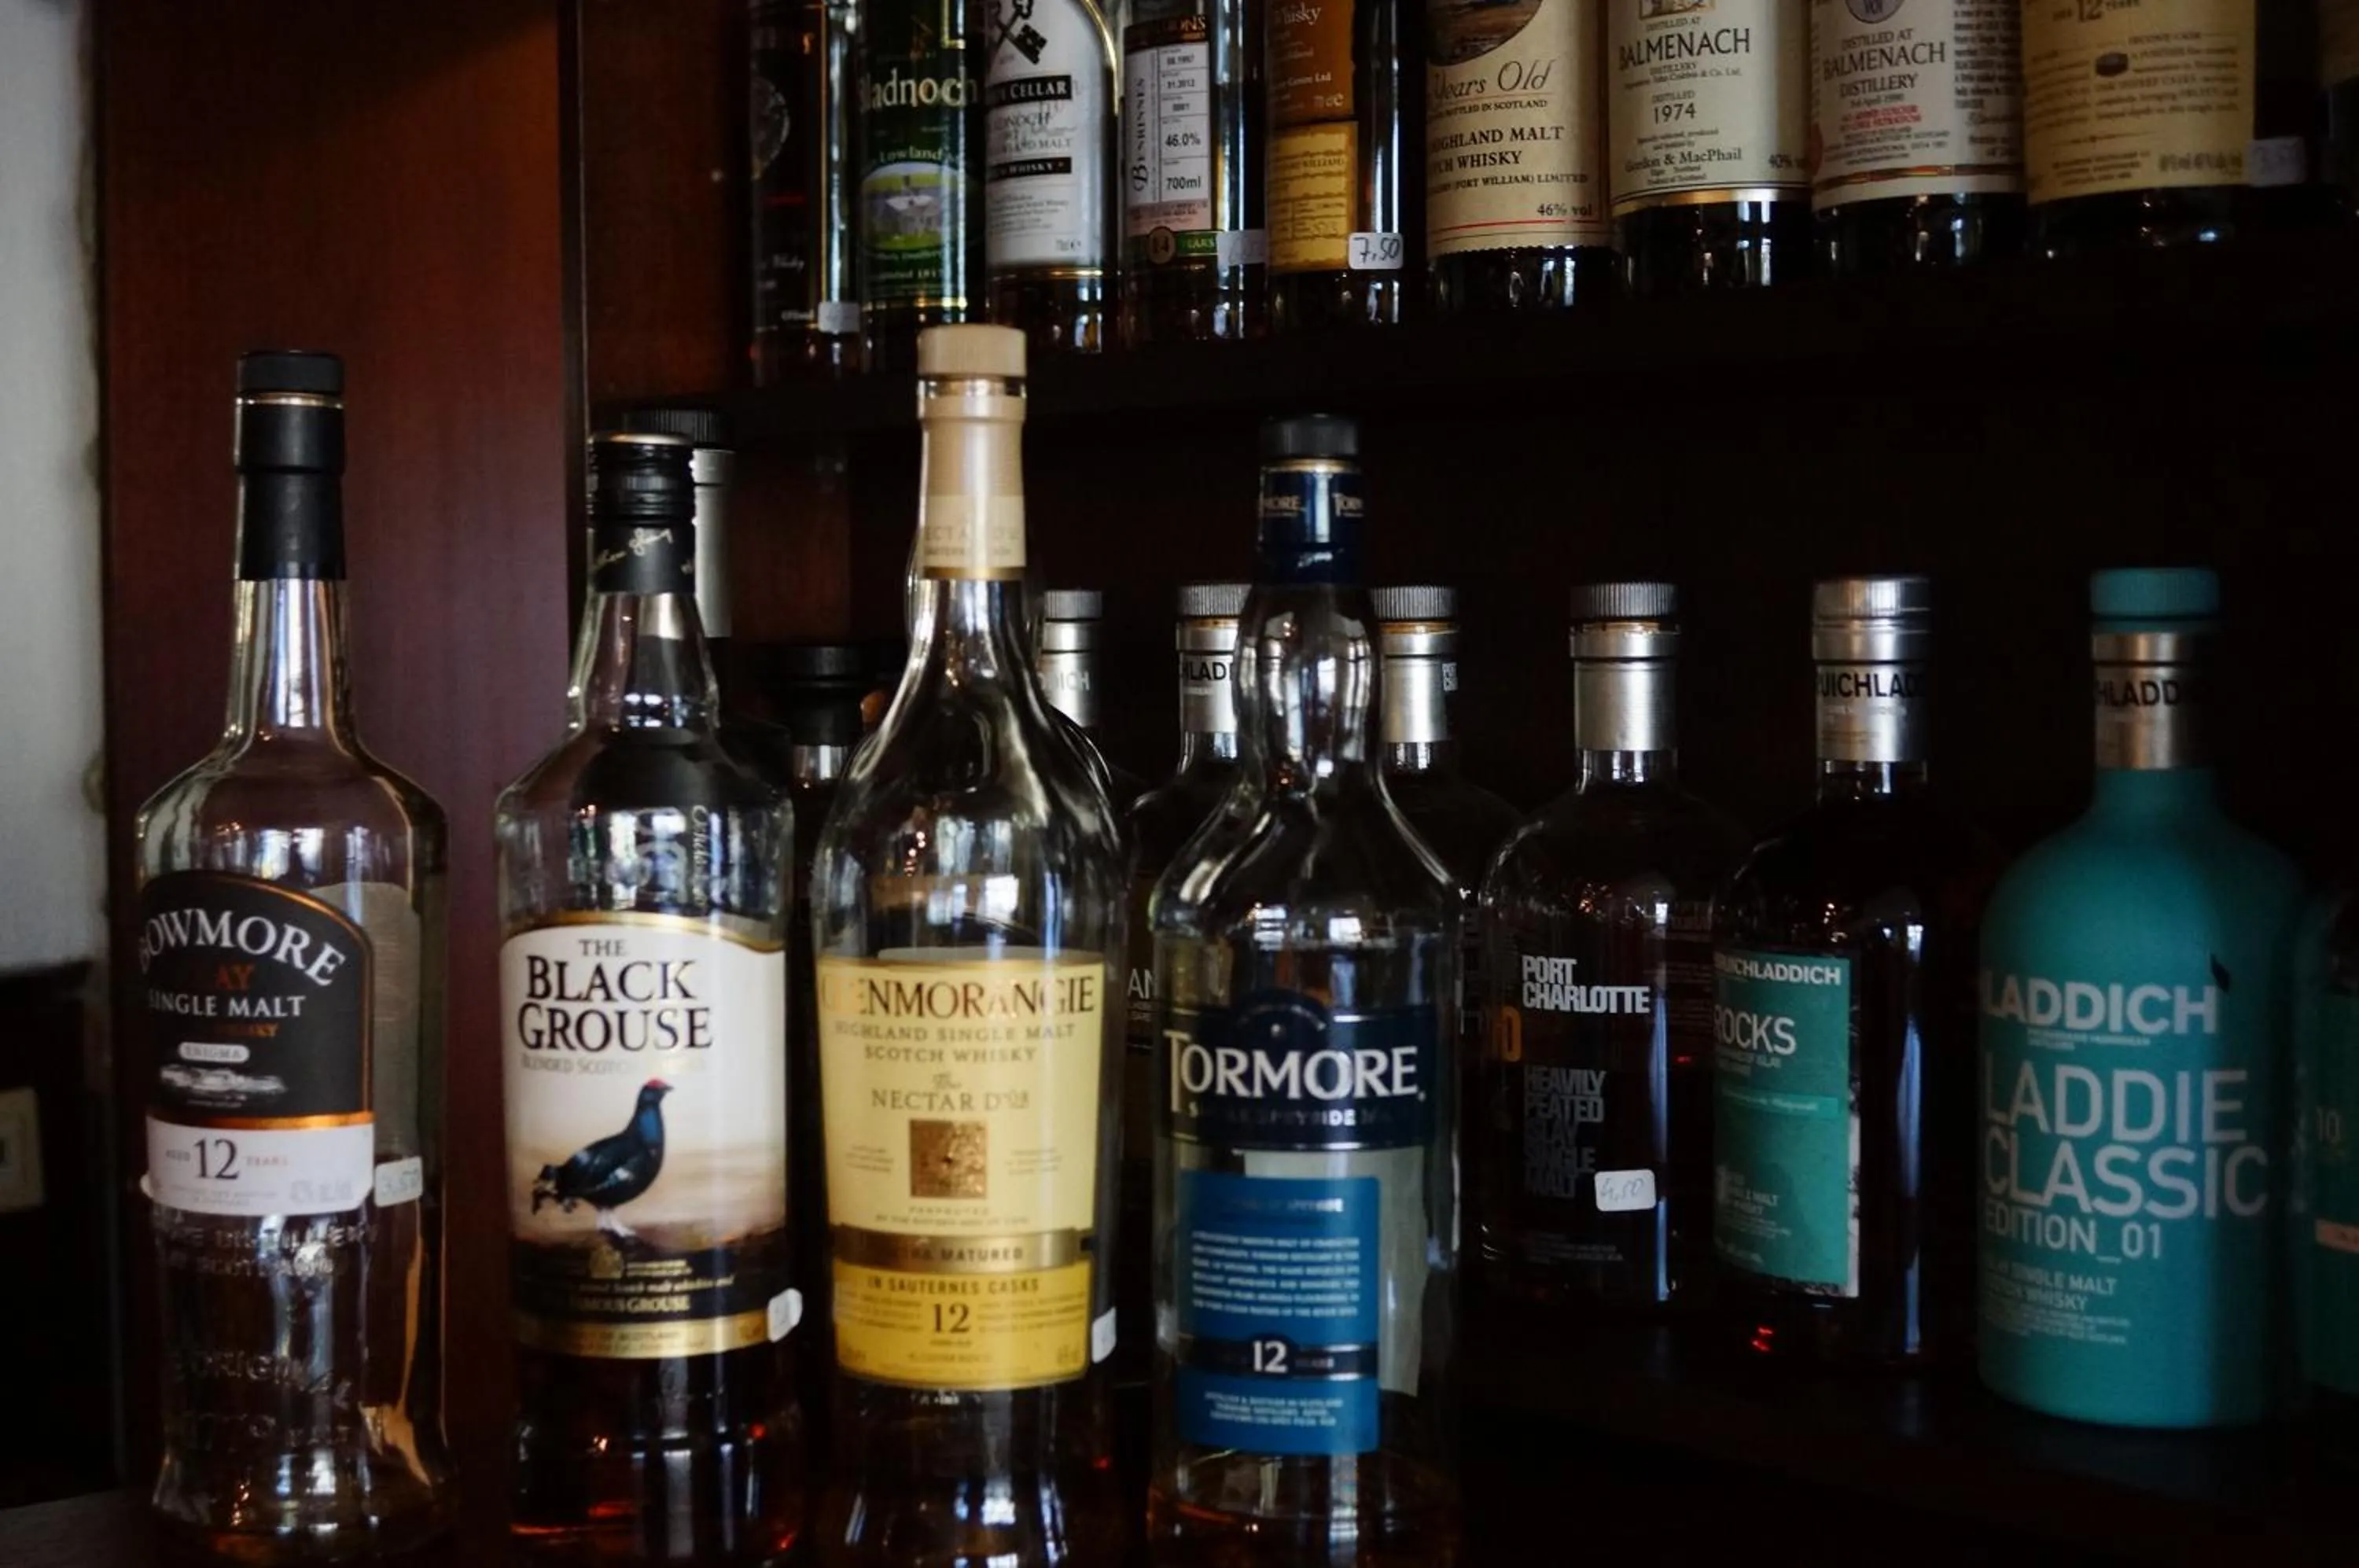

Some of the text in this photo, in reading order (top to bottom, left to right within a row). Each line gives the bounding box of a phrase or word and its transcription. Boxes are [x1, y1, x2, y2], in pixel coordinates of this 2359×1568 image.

[2077, 0, 2105, 22] 12
[1897, 28, 1913, 41] AT
[1619, 28, 1750, 71] BALMENACH
[1823, 42, 1945, 81] BALMENACH
[1496, 61, 1553, 92] Old
[1840, 74, 1916, 98] DISTILLERY
[1009, 79, 1067, 98] CELLAR
[1654, 101, 1696, 124] 1974
[1165, 132, 1202, 148] 46.0%
[1509, 126, 1565, 142] MALT
[1456, 150, 1523, 171] WHISKY
[1664, 153, 1676, 166] &
[1679, 148, 1742, 164] MacPhail
[1165, 175, 1202, 190] 700ml
[1537, 203, 1567, 216] 46%
[579, 939, 627, 958] THE
[526, 955, 698, 1003] BLACK
[1521, 954, 1578, 986] PORT
[227, 994, 307, 1018] MALT
[1522, 981, 1651, 1015] CHARLOTTE
[518, 1003, 714, 1052] GROUSE
[937, 1024, 1015, 1042] SINGLE
[1026, 1022, 1076, 1040] MALT
[865, 1046, 1037, 1063] SCOTCH WHISKY
[1524, 1065, 1607, 1098] HEAVILY
[871, 1090, 974, 1112] NECTAR
[1984, 1051, 2249, 1143] LADDIE
[193, 1139, 239, 1180] 12
[1983, 1130, 2269, 1220] CLASSIC
[940, 1247, 1023, 1261] MATURED
[889, 1278, 981, 1296] SAUTERNES
[988, 1278, 1040, 1294] CASKS
[2069, 1273, 2118, 1295] MALT
[2026, 1285, 2089, 1311] WHISKY
[933, 1302, 970, 1334] 12
[1251, 1339, 1290, 1374] 12
